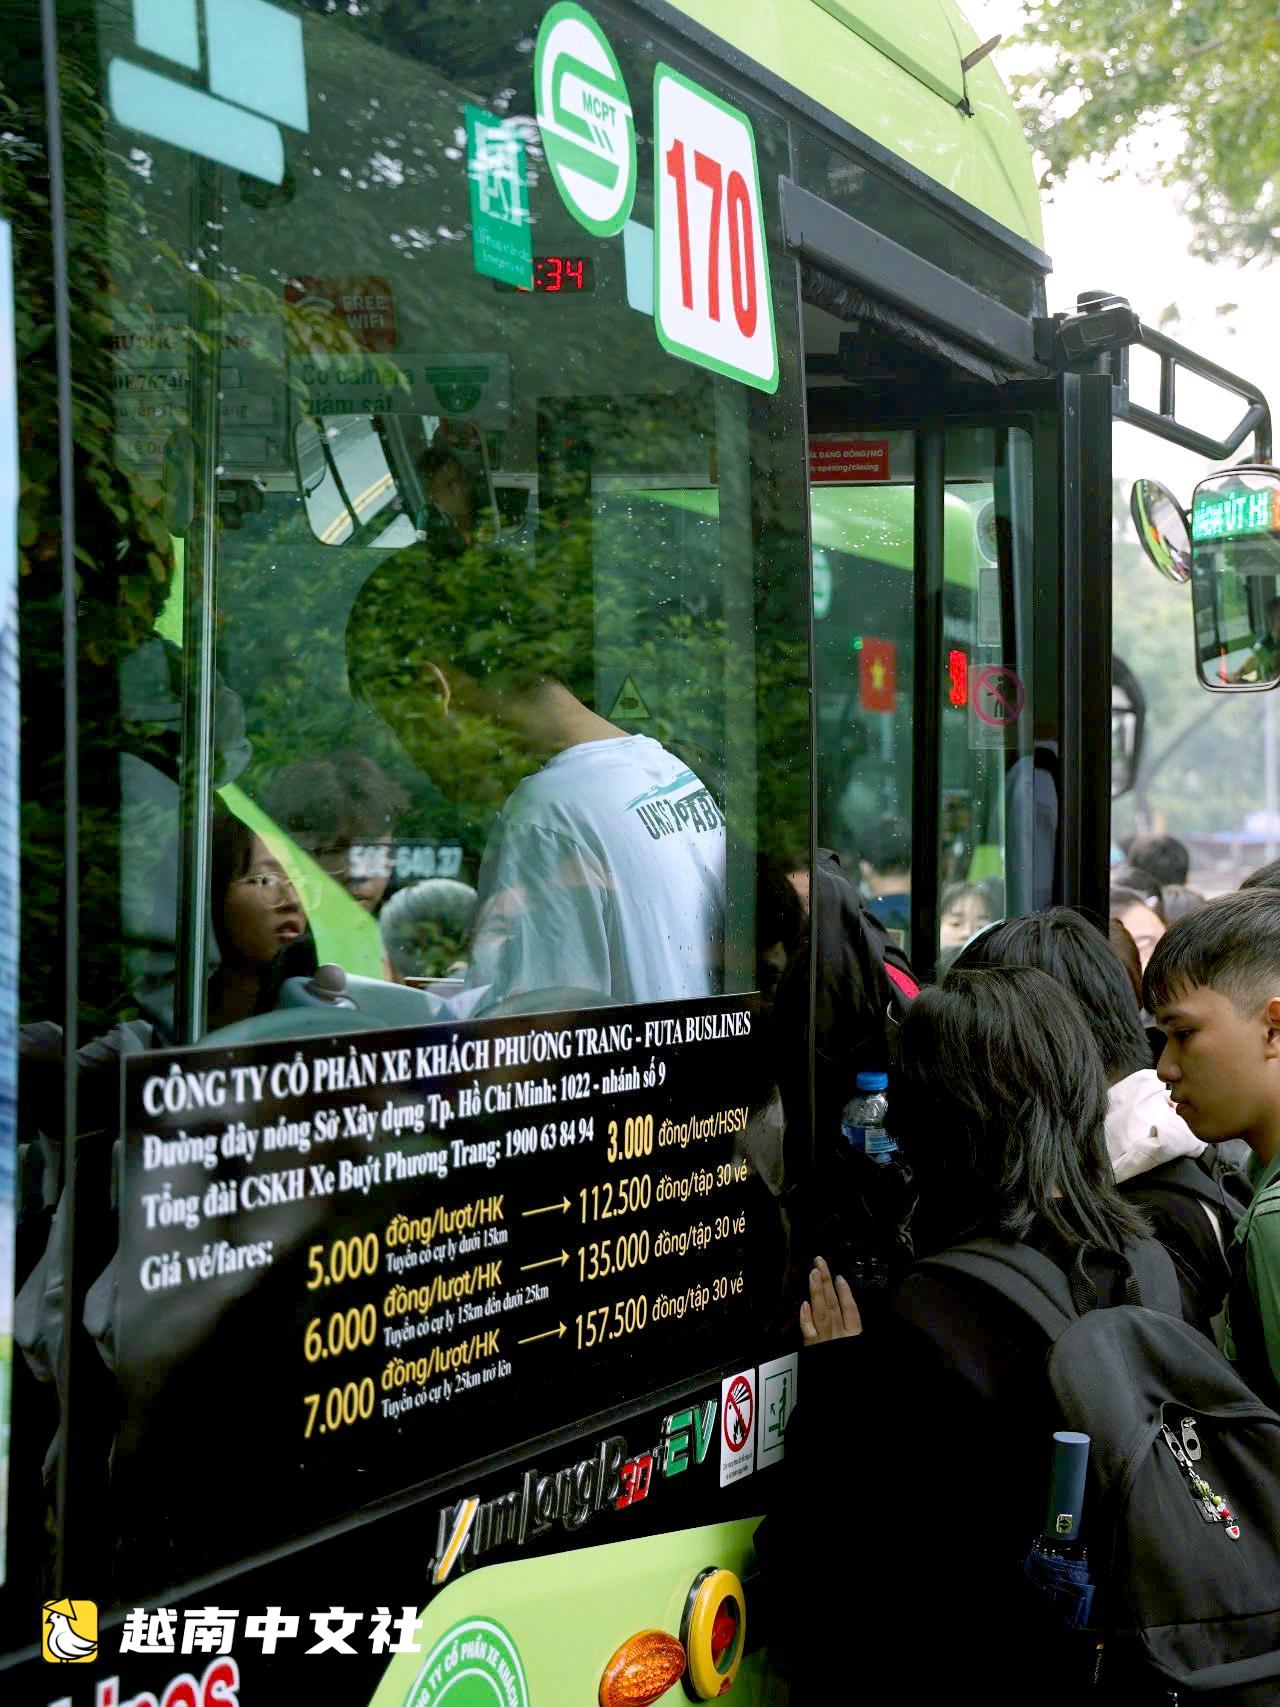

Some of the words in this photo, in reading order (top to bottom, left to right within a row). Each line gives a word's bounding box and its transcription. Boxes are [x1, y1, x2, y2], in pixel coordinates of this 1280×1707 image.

[583, 91, 618, 126] MCPT
[665, 137, 758, 341] 170
[342, 295, 387, 312] FREE
[143, 1062, 226, 1117] CÔNG
[231, 1065, 268, 1104] TY
[271, 1051, 309, 1098] CỔ
[313, 1045, 377, 1093] PHẦN
[382, 1049, 411, 1084] XE
[416, 1033, 490, 1079] KHÁCH
[494, 1029, 572, 1067] PHƯƠNG
[575, 1024, 633, 1056] TRANG
[644, 1019, 683, 1048] FUTA
[685, 1010, 751, 1042] BUSLINES
[143, 1130, 218, 1170] Đường
[221, 1121, 259, 1162] dây
[263, 1115, 311, 1153] nóng
[314, 1108, 340, 1142] Sở
[343, 1103, 378, 1141] Xây
[381, 1101, 425, 1136] dựng
[428, 1094, 455, 1129] Tp.
[458, 1080, 482, 1118] Hồ
[484, 1083, 512, 1113] Chí
[515, 1078, 557, 1108] Minh:
[560, 1072, 591, 1101] 1022
[602, 1065, 641, 1094] nhánh
[643, 1056, 656, 1088] số
[658, 1061, 666, 1086] 9
[607, 1113, 653, 1163] 3.000
[658, 1107, 749, 1148] đồng/lượt/HSSV
[141, 1181, 199, 1230] Tổng
[203, 1180, 237, 1217] đài
[240, 1167, 305, 1210] CSKH
[308, 1164, 335, 1197] Xe
[338, 1155, 381, 1195] Buýt
[384, 1149, 448, 1179] Phương
[451, 1138, 501, 1169] Trang:
[505, 1126, 538, 1158] 1900
[540, 1122, 557, 1150] 63
[559, 1119, 576, 1147] 84
[578, 1116, 594, 1144] 94
[307, 1233, 379, 1290] 5.000
[386, 1195, 504, 1247] đồng/lượt/HK
[580, 1173, 651, 1224] 112.500
[656, 1168, 713, 1201] đồng/tập
[716, 1164, 731, 1187] 30
[734, 1159, 748, 1182] vé
[419, 1244, 431, 1264] có
[433, 1246, 445, 1265] cự
[447, 1239, 457, 1262] ly
[459, 1232, 481, 1254] dưới
[483, 1227, 508, 1246] 15km
[140, 1251, 182, 1291] Giá
[187, 1240, 273, 1281] vé/fares:
[304, 1304, 377, 1363] 6.000
[383, 1260, 502, 1318] đồng/lượt/HK
[578, 1229, 650, 1282] 135.000
[654, 1222, 712, 1258] đồng/tập
[714, 1215, 730, 1239] 30
[732, 1211, 746, 1234] vé
[416, 1316, 430, 1337] có
[431, 1316, 444, 1334] cự
[445, 1309, 455, 1332] ly
[458, 1303, 483, 1324] 15km
[484, 1291, 501, 1317] đến
[503, 1287, 524, 1311] dưới
[525, 1283, 549, 1305] 25km
[303, 1377, 375, 1439] 7.000
[381, 1328, 500, 1391] đồng/lượt/HK
[575, 1294, 648, 1350] 157.500
[652, 1284, 710, 1321] đồng/tập
[712, 1276, 728, 1301] 30
[730, 1270, 744, 1294] vé
[414, 1386, 427, 1407] có
[428, 1384, 442, 1403] cự
[443, 1378, 452, 1401] ly
[454, 1371, 481, 1394] 25km
[482, 1363, 496, 1384] trở
[497, 1359, 512, 1380] lên
[662, 1399, 718, 1478] EV
[415, 1687, 431, 1707] NG
[429, 1664, 443, 1690] TY
[486, 1646, 501, 1669] XE
